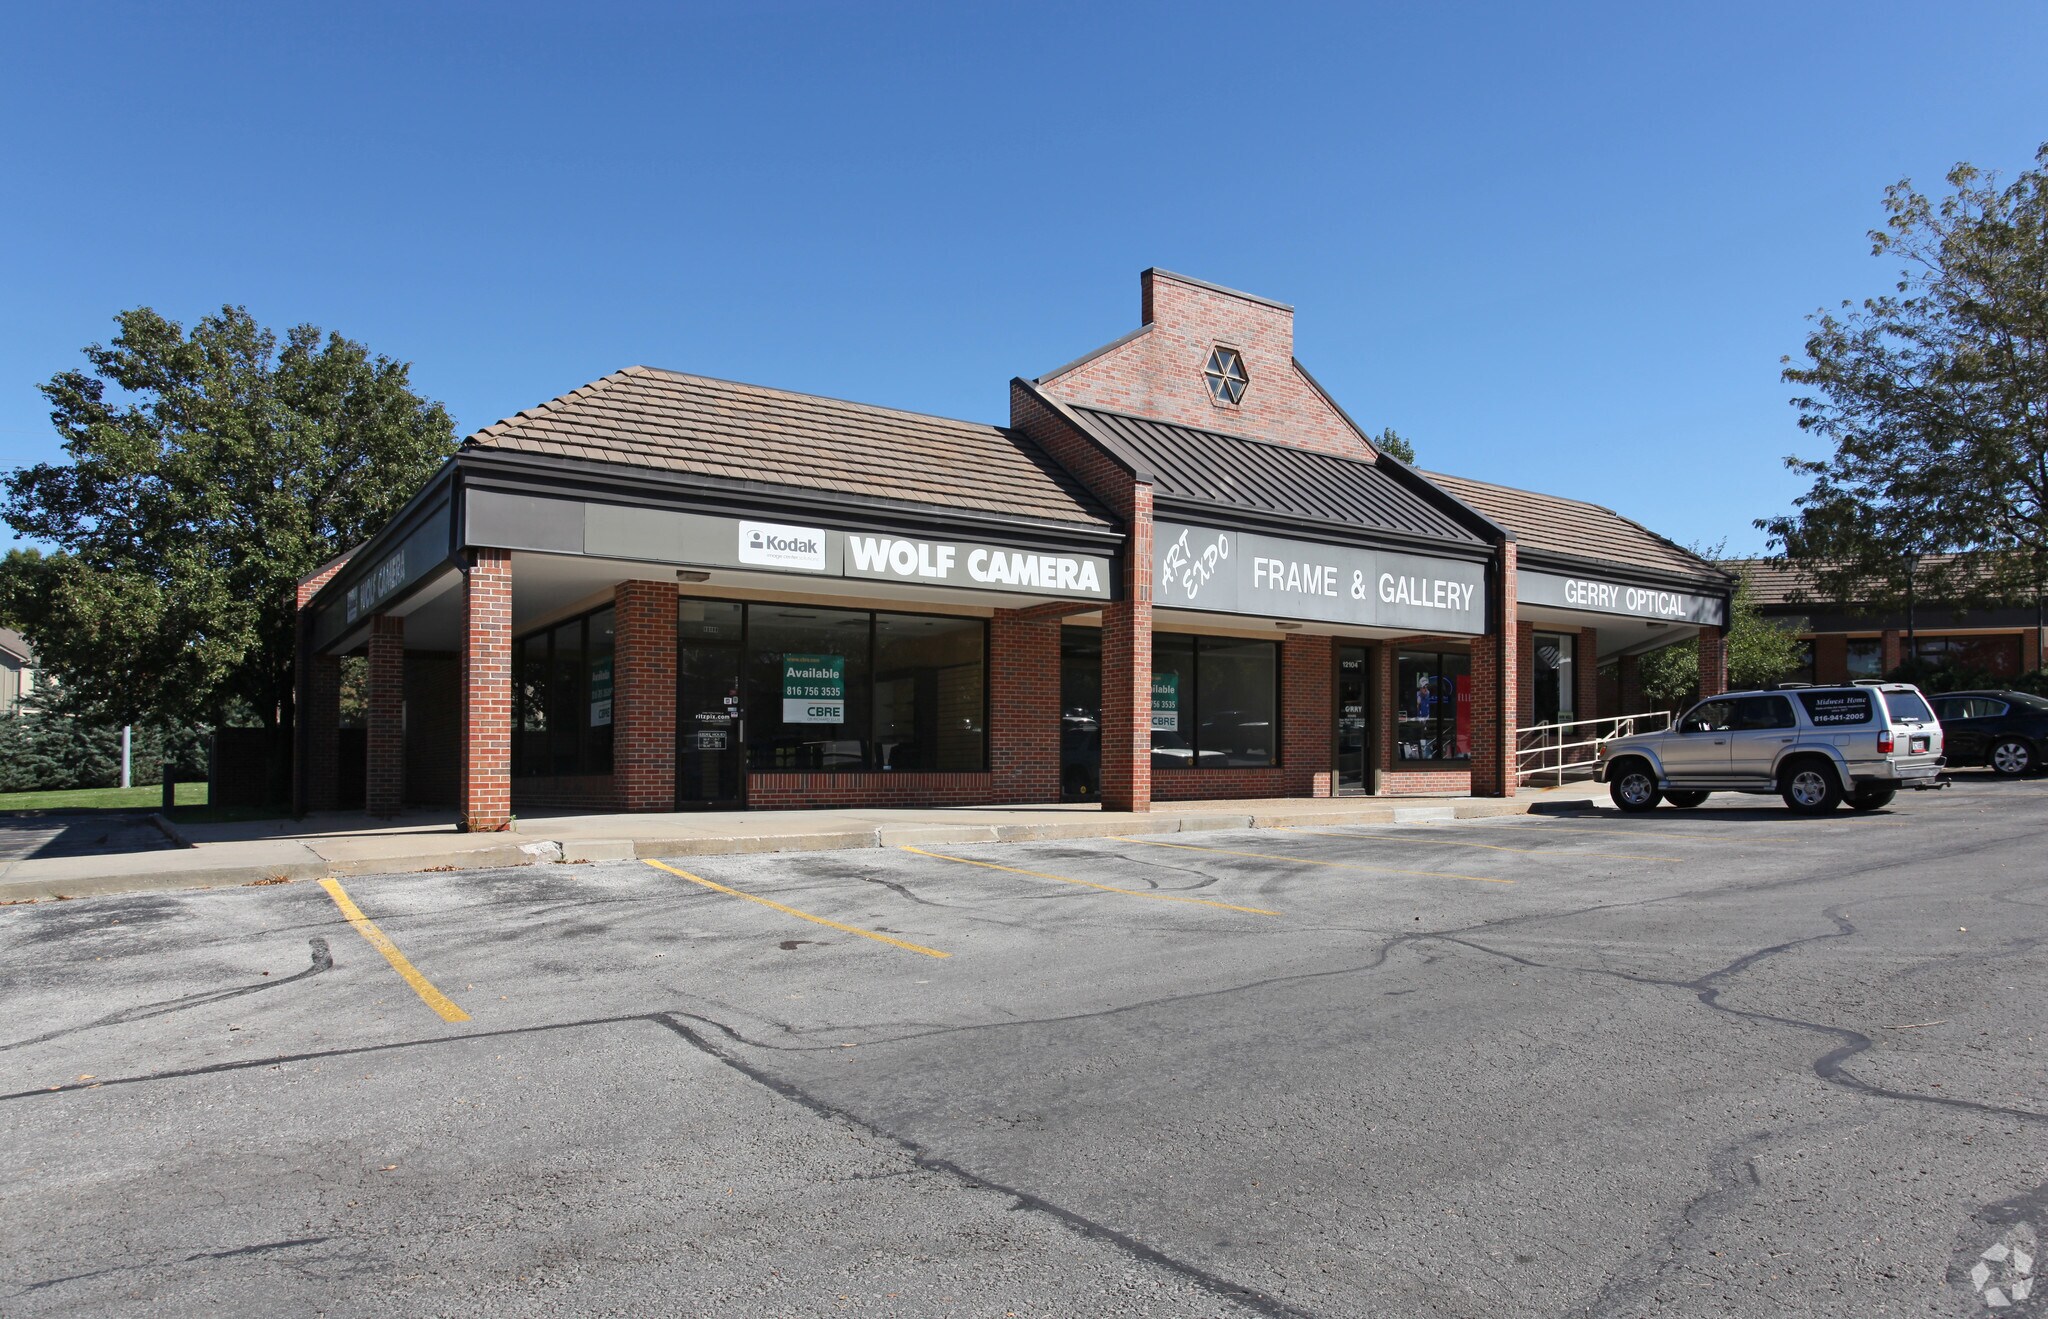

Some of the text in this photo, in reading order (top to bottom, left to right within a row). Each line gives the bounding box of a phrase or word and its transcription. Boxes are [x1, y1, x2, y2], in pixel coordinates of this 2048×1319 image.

[767, 535, 818, 554] Kodak
[849, 536, 1101, 593] WOLF CAMERA
[1162, 529, 1191, 595] ART
[1182, 534, 1229, 600] EXPO
[361, 573, 377, 612] WOLF
[378, 549, 406, 599] CAMERA
[1253, 556, 1475, 612] FRAME & GALLERY
[1564, 579, 1687, 617] GERRY OPTICAL
[786, 667, 840, 679] Available
[786, 686, 841, 696] 816 756 3535
[1152, 685, 1175, 694] ilable
[1161, 700, 1176, 709] 3535
[1815, 698, 1845, 706] Midwest
[695, 713, 731, 721] ritzpix.com
[807, 706, 841, 717] CBRE
[1814, 711, 1865, 722] 816-941-2005
[1151, 716, 1176, 726] CBRE
